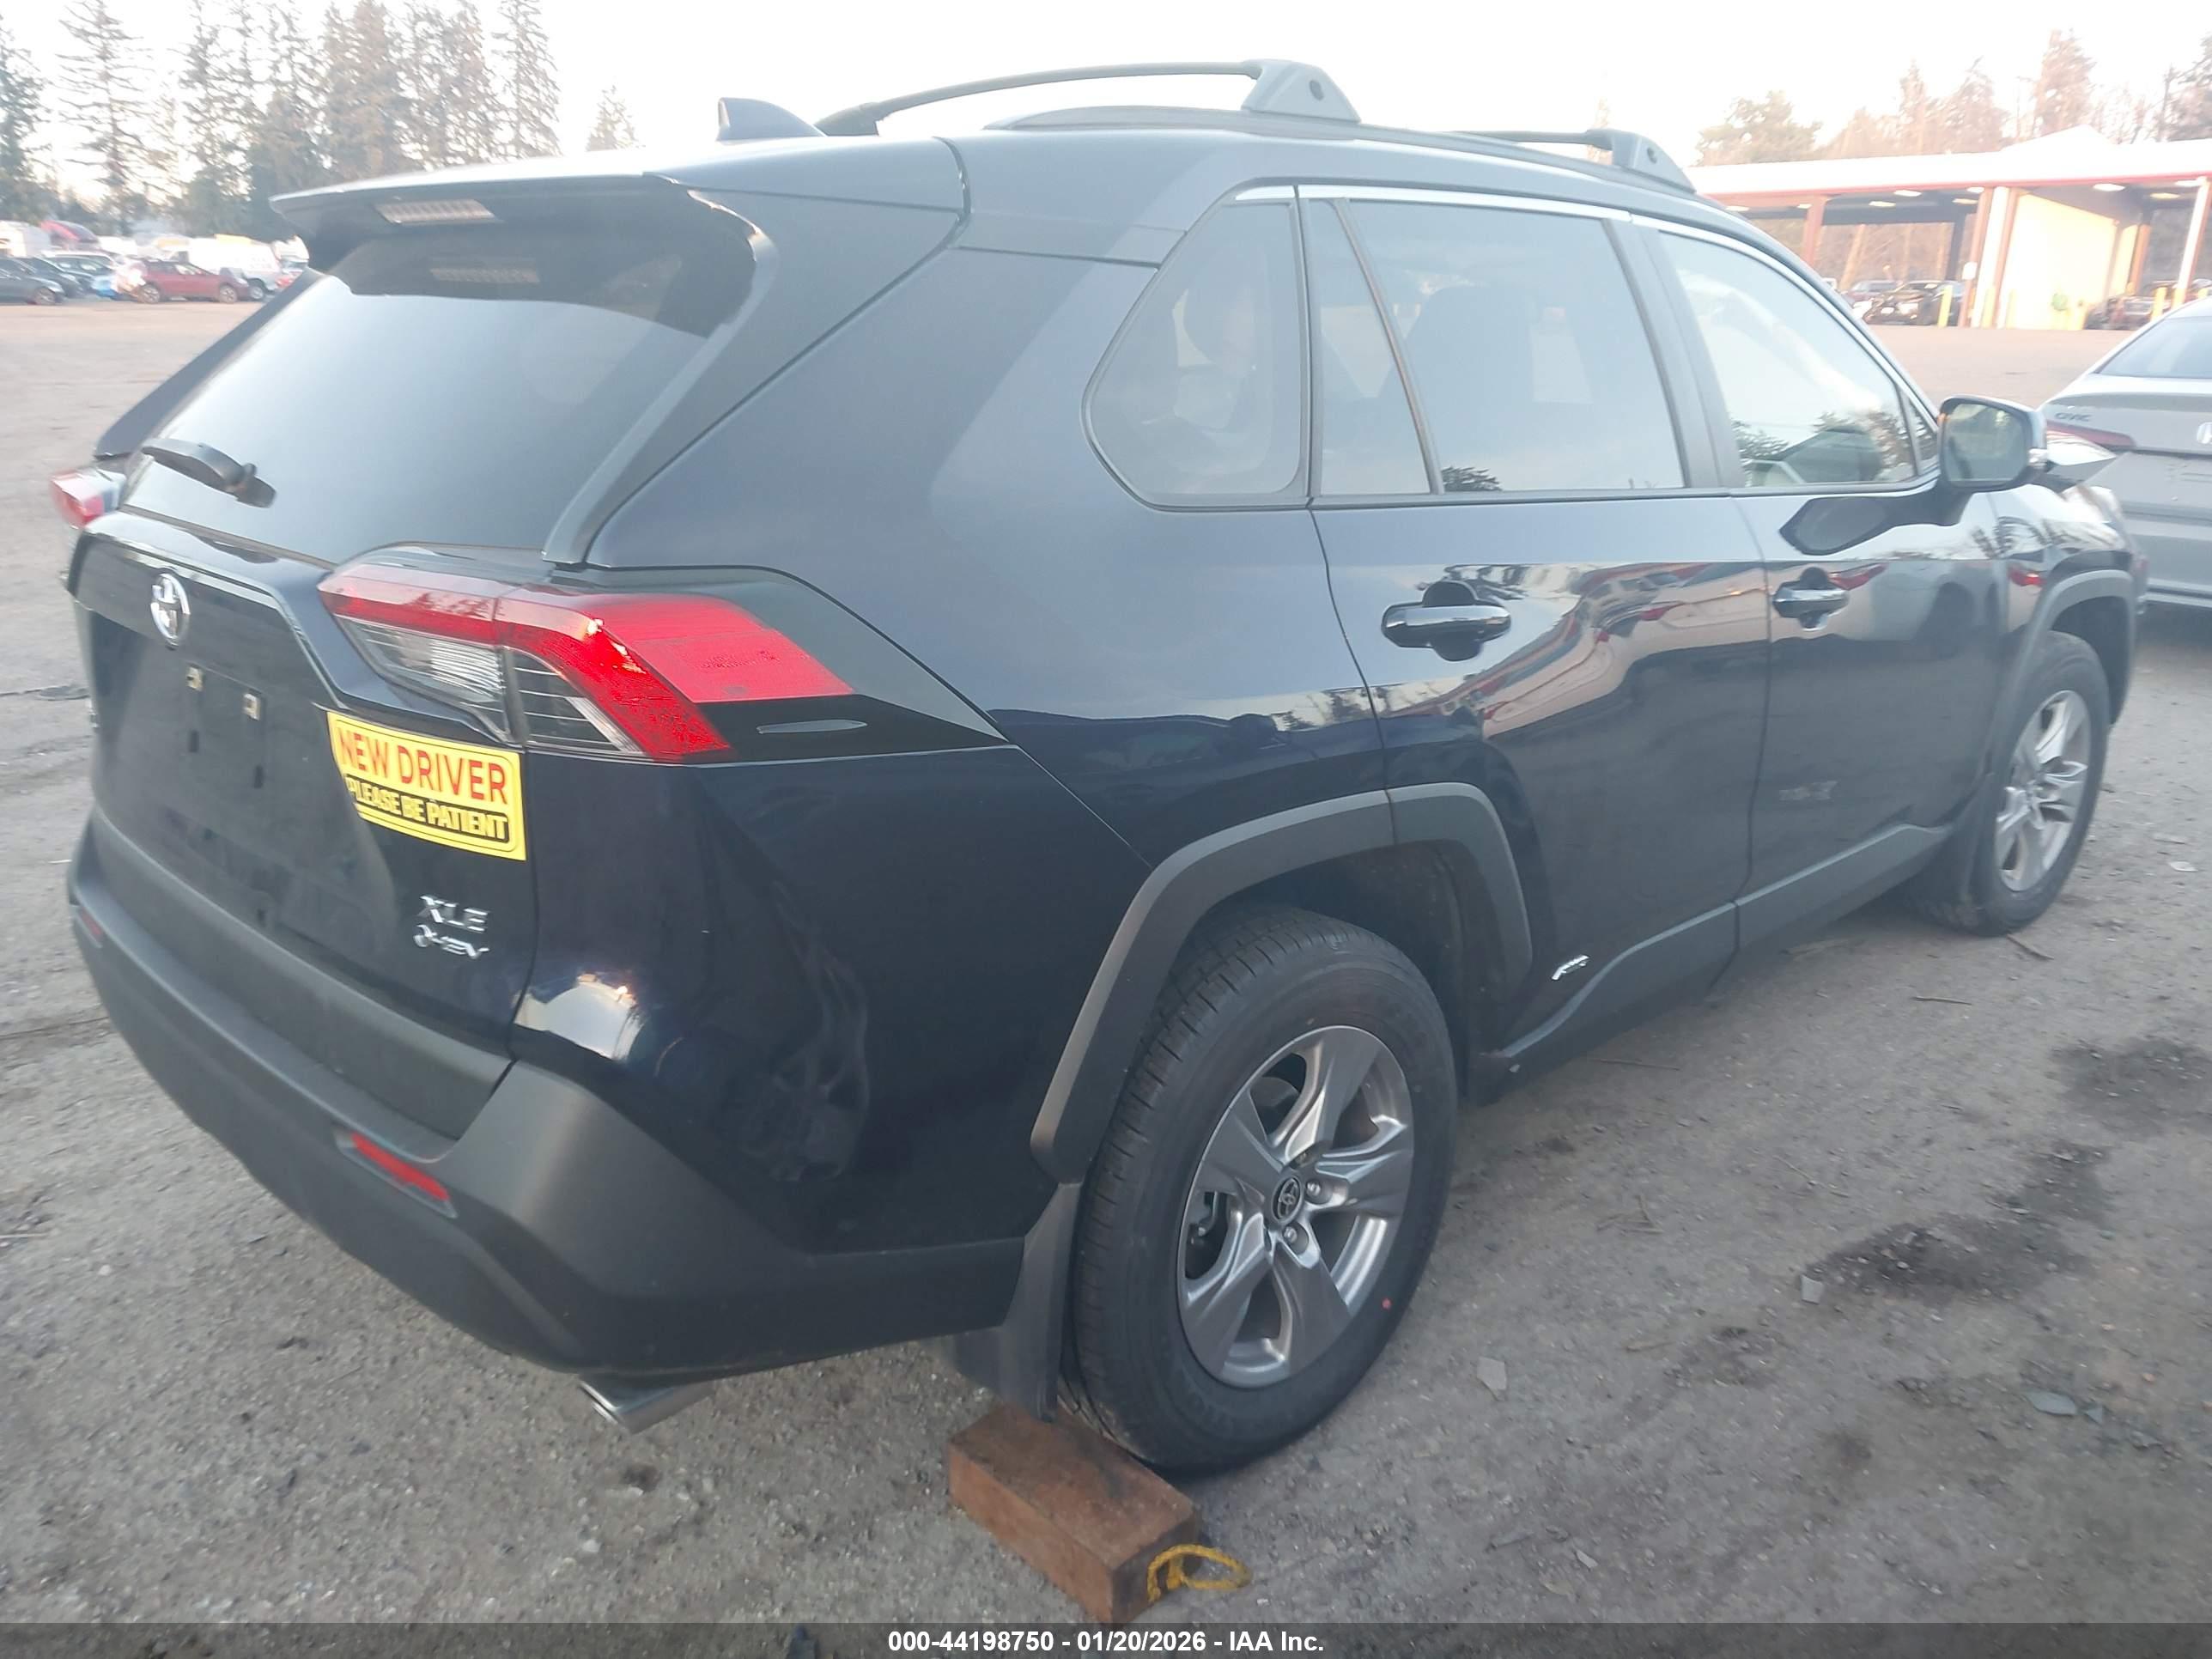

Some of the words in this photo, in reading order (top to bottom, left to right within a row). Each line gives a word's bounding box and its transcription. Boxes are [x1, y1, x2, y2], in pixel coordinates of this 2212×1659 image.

[336, 727, 390, 778] NEW
[397, 745, 507, 805] DRIVER
[347, 776, 401, 816] PLEASE
[400, 795, 425, 823] BE
[427, 802, 507, 840] PATIENT
[416, 895, 490, 933] XLE
